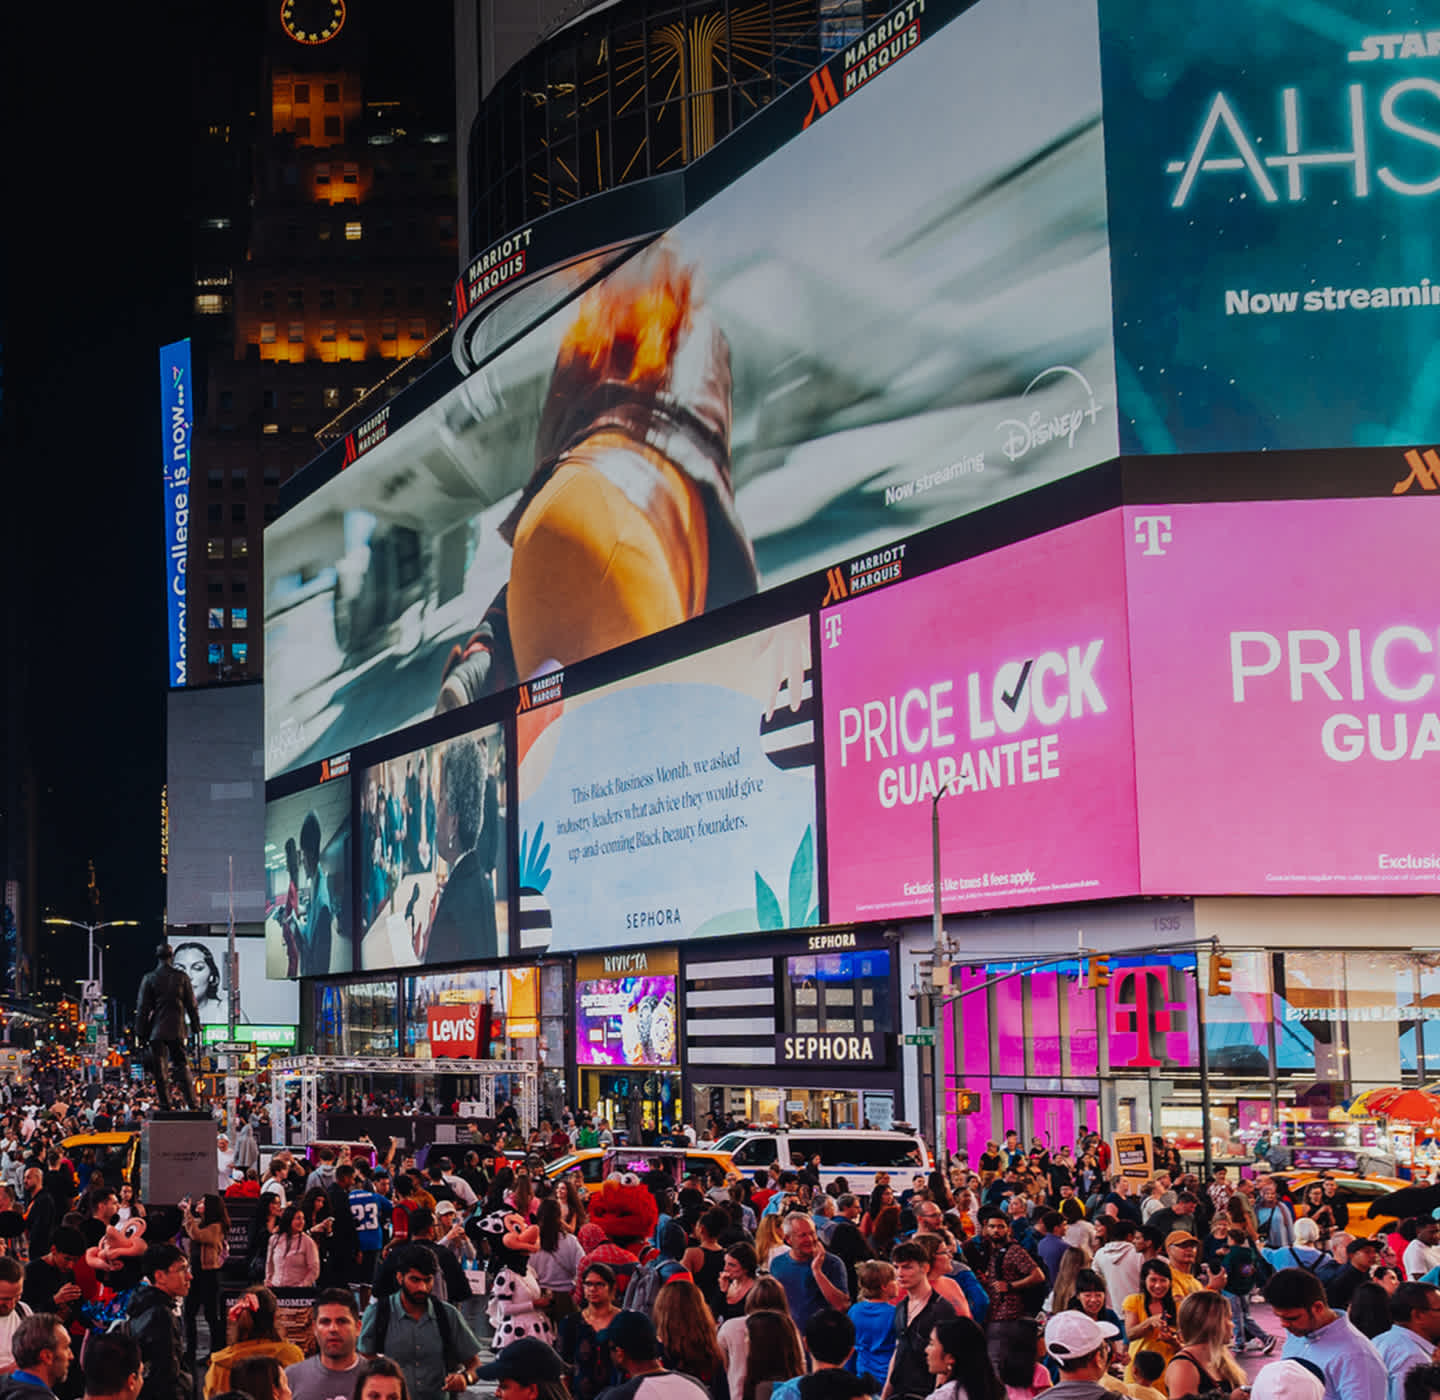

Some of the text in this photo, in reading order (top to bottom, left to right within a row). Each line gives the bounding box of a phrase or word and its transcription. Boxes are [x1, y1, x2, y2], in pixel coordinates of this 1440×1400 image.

[844, 0, 926, 69] MARRIOTT
[845, 25, 918, 92] MARQUIS
[469, 229, 532, 283] MARRIOTT
[469, 254, 524, 305] MARQUIS
[1225, 289, 1299, 316] Now
[358, 406, 391, 439] MARRIOTT
[995, 380, 1103, 462] Disney+
[358, 424, 388, 452] MARQUIS
[170, 464, 187, 488] is
[884, 450, 985, 506] Now streaming
[850, 544, 907, 575] MARRIOTT
[850, 563, 901, 593] MARQUIS
[1229, 624, 1440, 703] PRIC
[532, 685, 561, 705] MARQUIS
[839, 639, 1108, 768] PRICE LOCK
[572, 787, 591, 804] This
[591, 779, 614, 800] Black
[615, 773, 655, 794] Business
[693, 759, 709, 774] we
[709, 746, 741, 769] asked
[878, 734, 1060, 809] GUARANTEE
[681, 791, 703, 811] they
[705, 779, 739, 802] would
[740, 776, 764, 801] give
[697, 813, 749, 838] founders.
[990, 872, 1010, 886] fees
[625, 907, 682, 930] SEPHORA
[808, 933, 857, 951] SEPHORA
[603, 952, 649, 973] INVICTA
[784, 1035, 874, 1062] SEPHORA
[350, 1202, 379, 1231] 23
